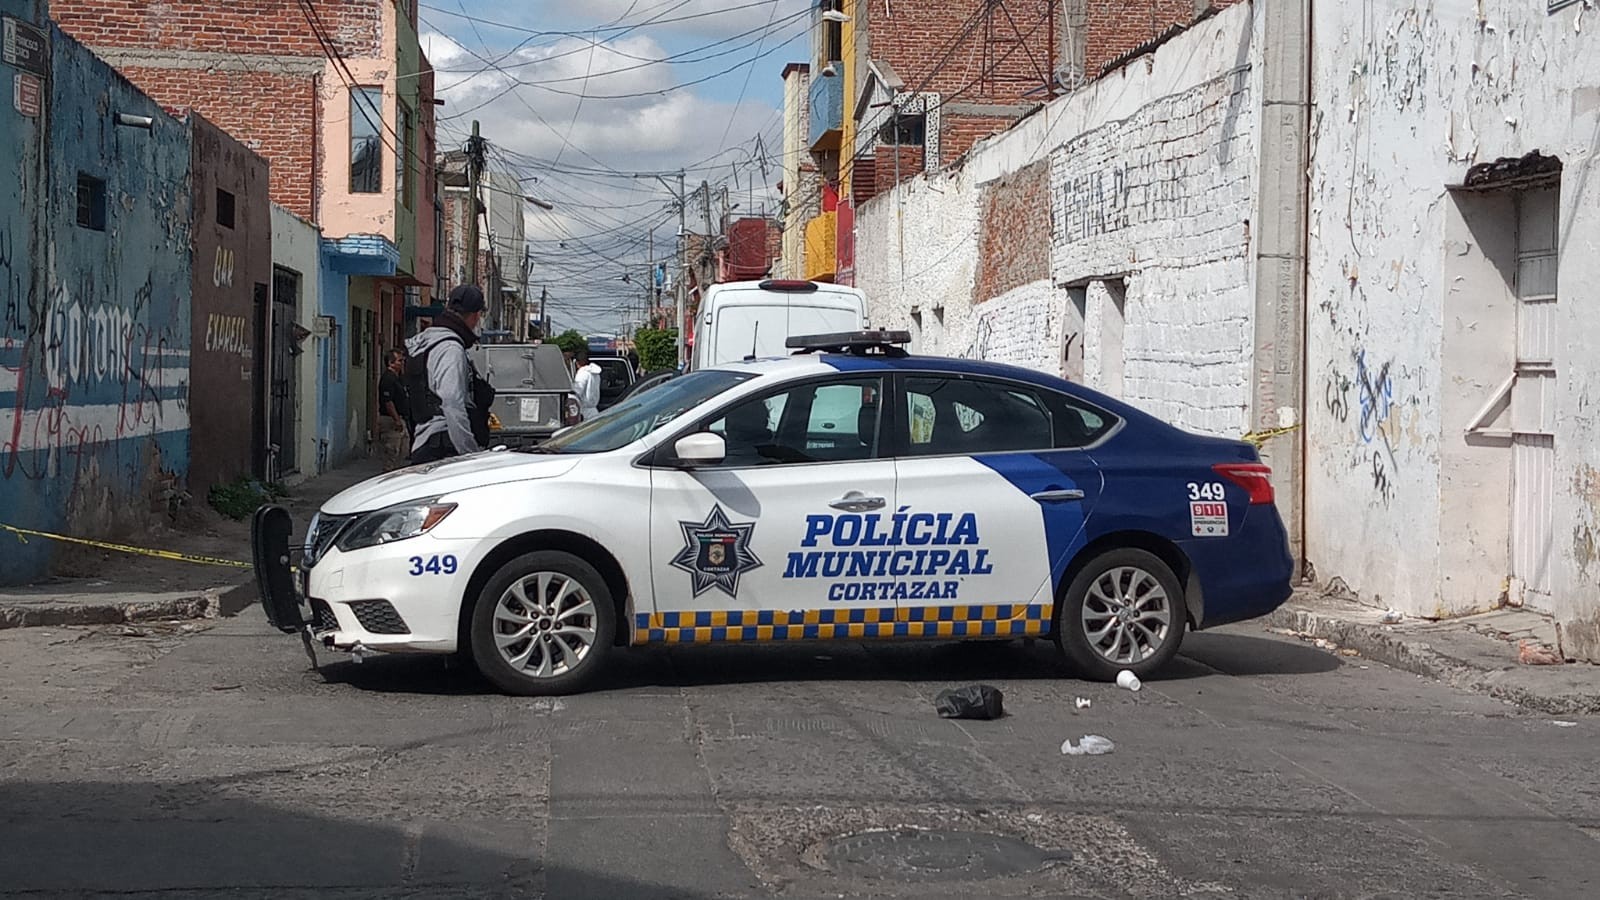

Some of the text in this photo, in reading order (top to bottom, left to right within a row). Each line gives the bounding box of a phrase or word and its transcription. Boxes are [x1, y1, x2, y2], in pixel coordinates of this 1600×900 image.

[213, 245, 235, 288] BAR
[1187, 482, 1225, 500] 349
[1194, 504, 1223, 515] 911
[801, 505, 980, 547] POLÍCIA
[409, 554, 458, 576] 349
[783, 549, 993, 578] MUNICIPAL
[828, 581, 959, 600] CORTAZAR
